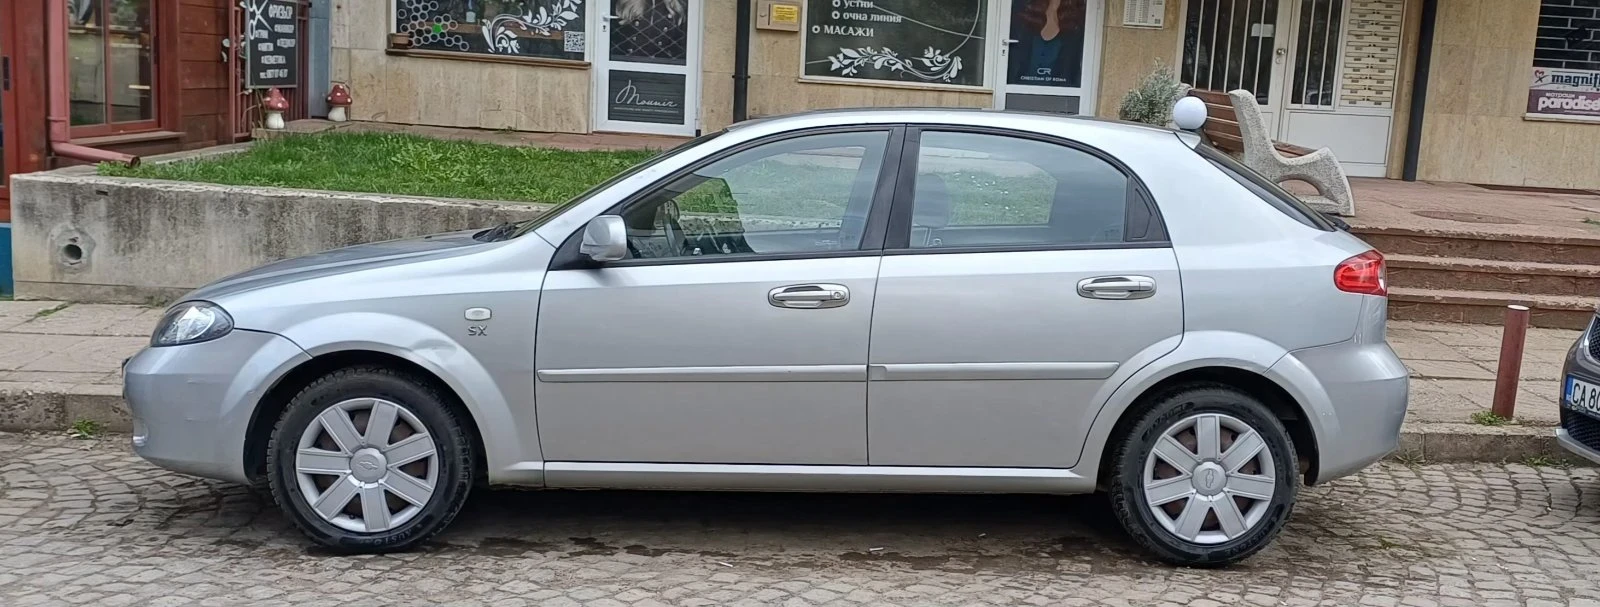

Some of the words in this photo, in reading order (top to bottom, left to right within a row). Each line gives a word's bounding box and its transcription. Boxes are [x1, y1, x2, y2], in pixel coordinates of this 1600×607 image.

[843, 0, 874, 9] устни
[843, 12, 868, 20] очна
[870, 13, 902, 23] линия
[824, 25, 874, 37] МАСАЖИ
[1551, 73, 1600, 87] magnif
[467, 325, 488, 337] SX
[1572, 383, 1586, 407] CA
